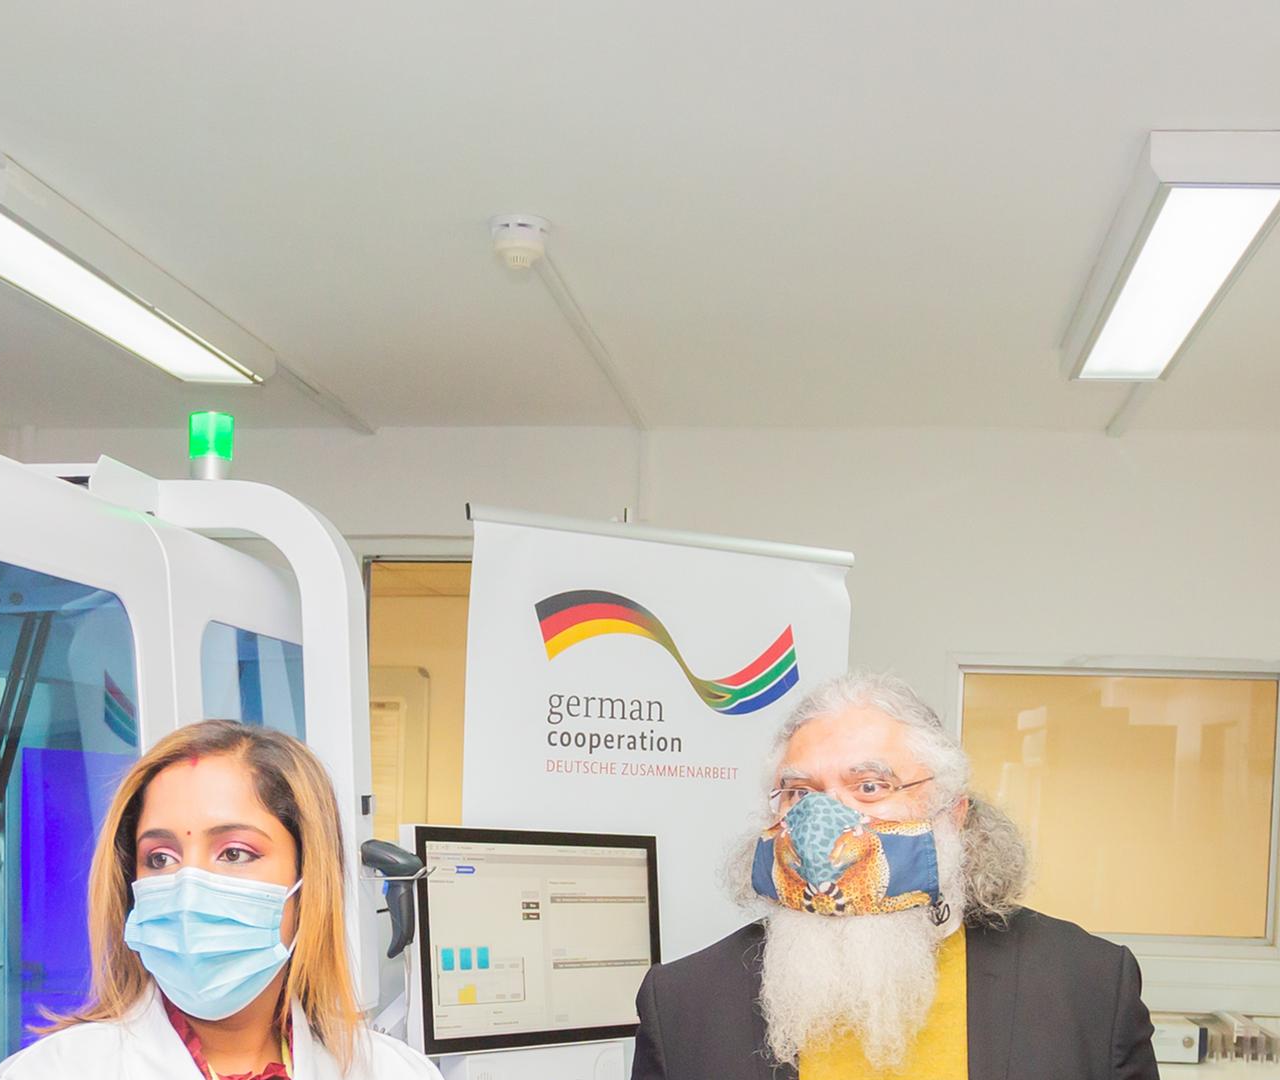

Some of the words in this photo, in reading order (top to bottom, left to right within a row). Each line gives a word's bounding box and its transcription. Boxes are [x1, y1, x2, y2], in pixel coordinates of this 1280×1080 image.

[547, 693, 665, 725] german
[547, 730, 682, 754] cooperation
[546, 759, 617, 775] DEUTSCHE
[621, 762, 739, 780] ZUSAMMENARBEIT
